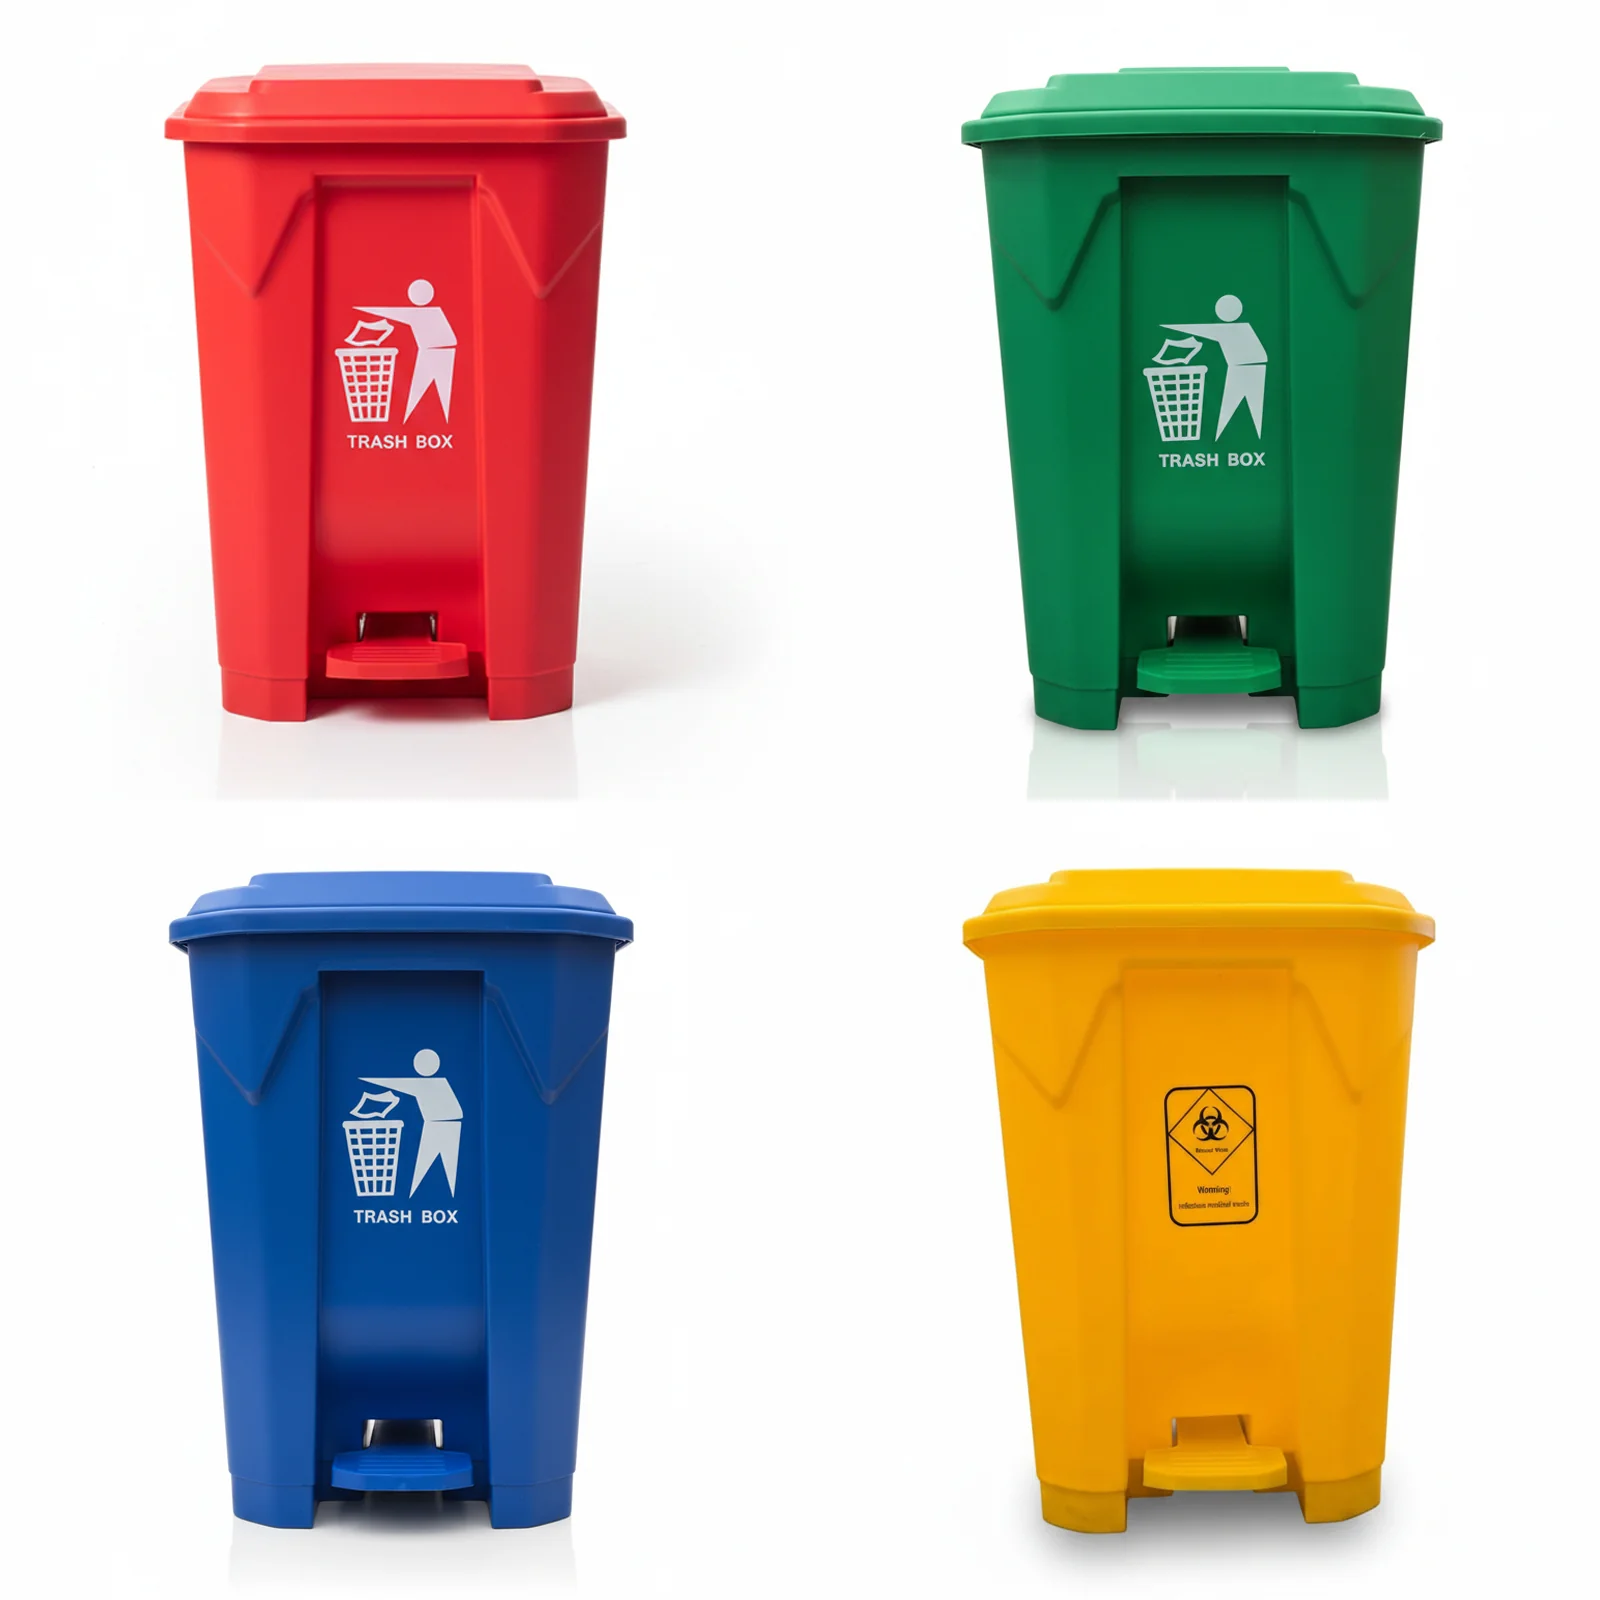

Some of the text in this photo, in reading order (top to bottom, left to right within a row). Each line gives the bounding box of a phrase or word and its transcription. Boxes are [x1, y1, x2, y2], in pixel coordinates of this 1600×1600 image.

[347, 435, 453, 449] TRASH BOX
[1159, 453, 1266, 468] TRASH BOX
[354, 1210, 459, 1224] TRASH BOX
